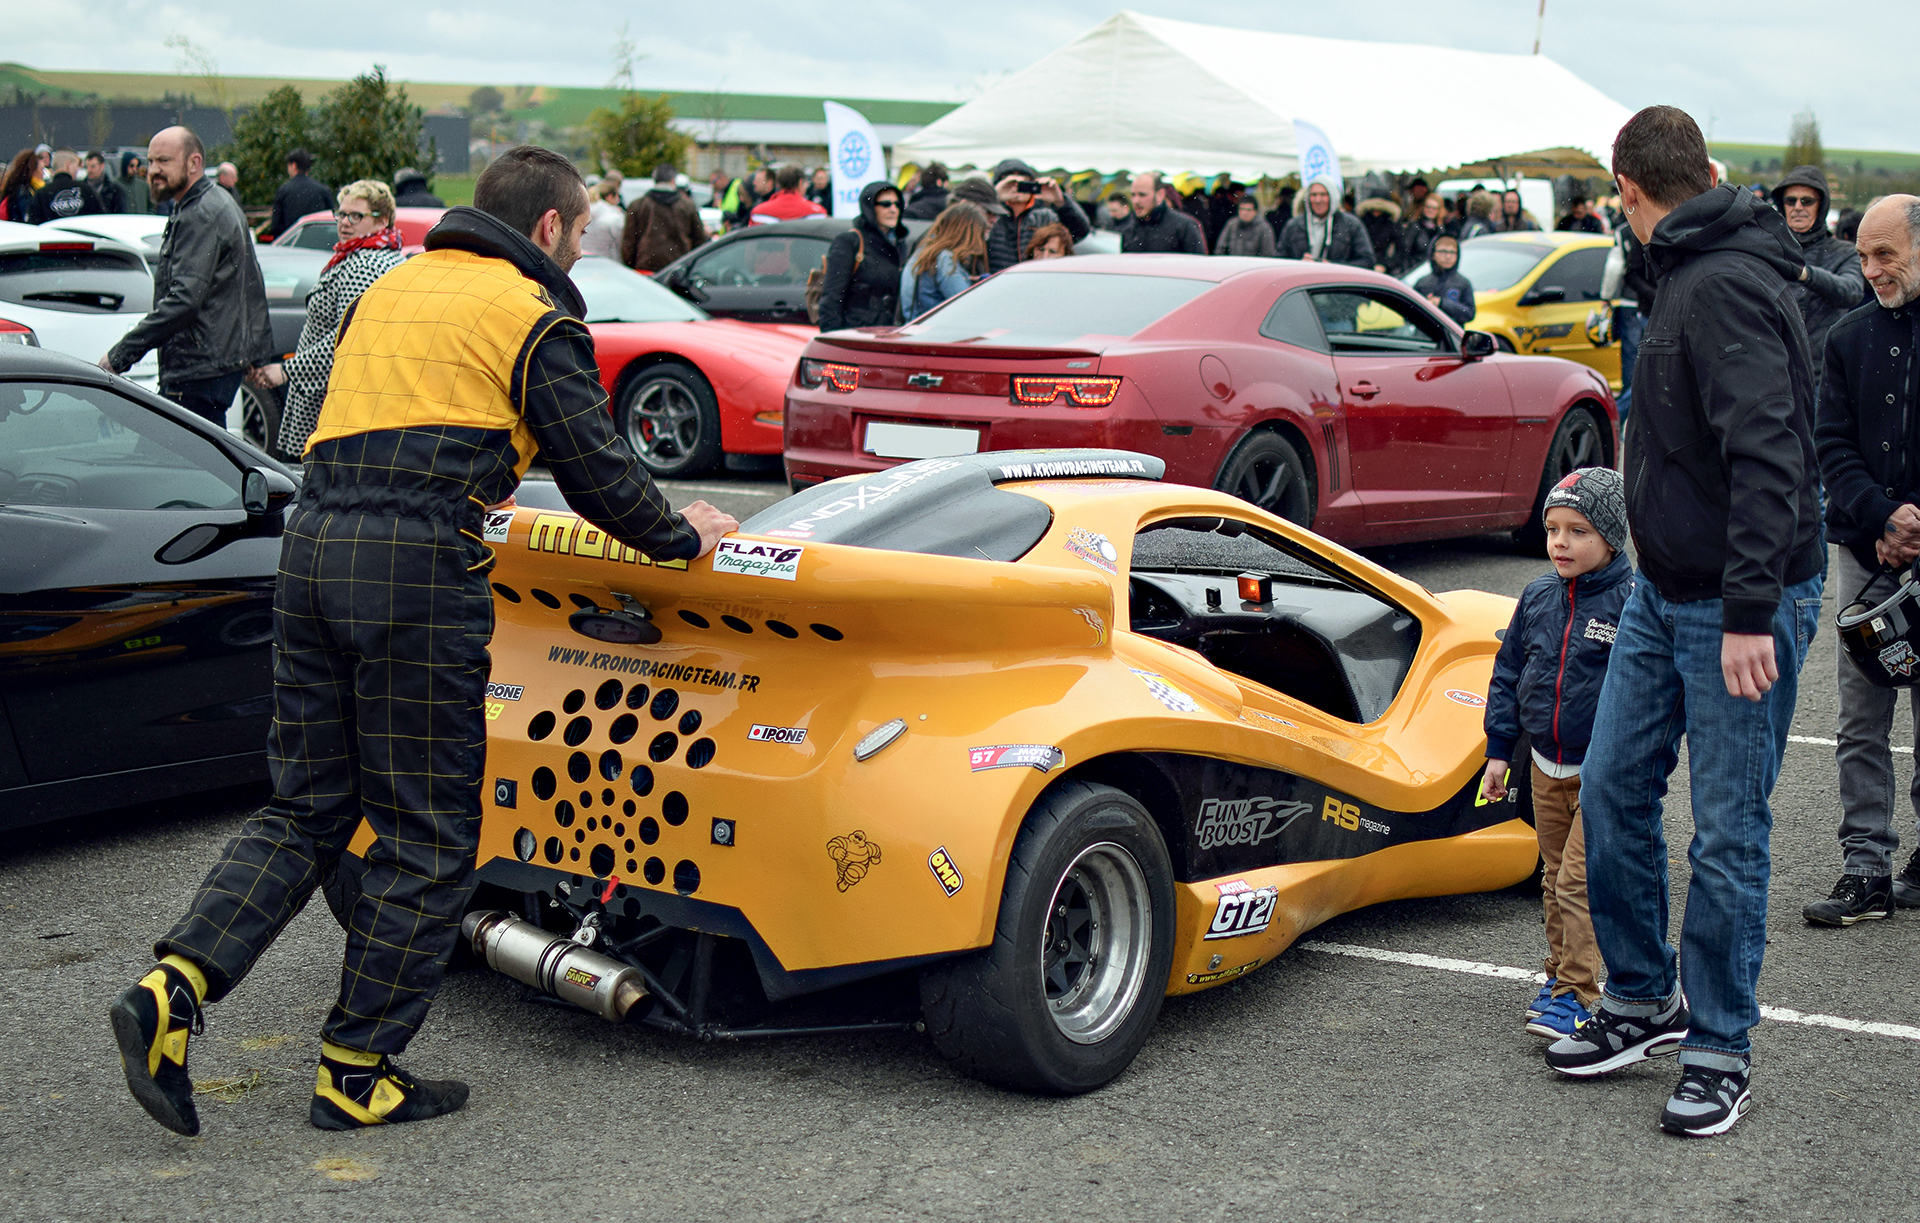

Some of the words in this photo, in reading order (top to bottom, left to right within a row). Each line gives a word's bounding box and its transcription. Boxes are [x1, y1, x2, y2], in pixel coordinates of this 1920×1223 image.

[999, 459, 1146, 479] WWW.KRONORACINGTEAM.FR
[716, 554, 796, 575] magazine
[548, 646, 760, 693] WWW.KRONORACINGTEAM.FR
[486, 683, 523, 700] PONE
[761, 726, 806, 743] IPONE
[971, 751, 995, 764] 57
[1015, 748, 1052, 759] MOTO
[1017, 756, 1051, 766] EXPERT
[1322, 795, 1361, 831] RS
[1359, 816, 1391, 835] magazine
[1201, 817, 1266, 845] BOOST
[931, 852, 960, 889] OMP
[1218, 880, 1252, 894] MOTUL
